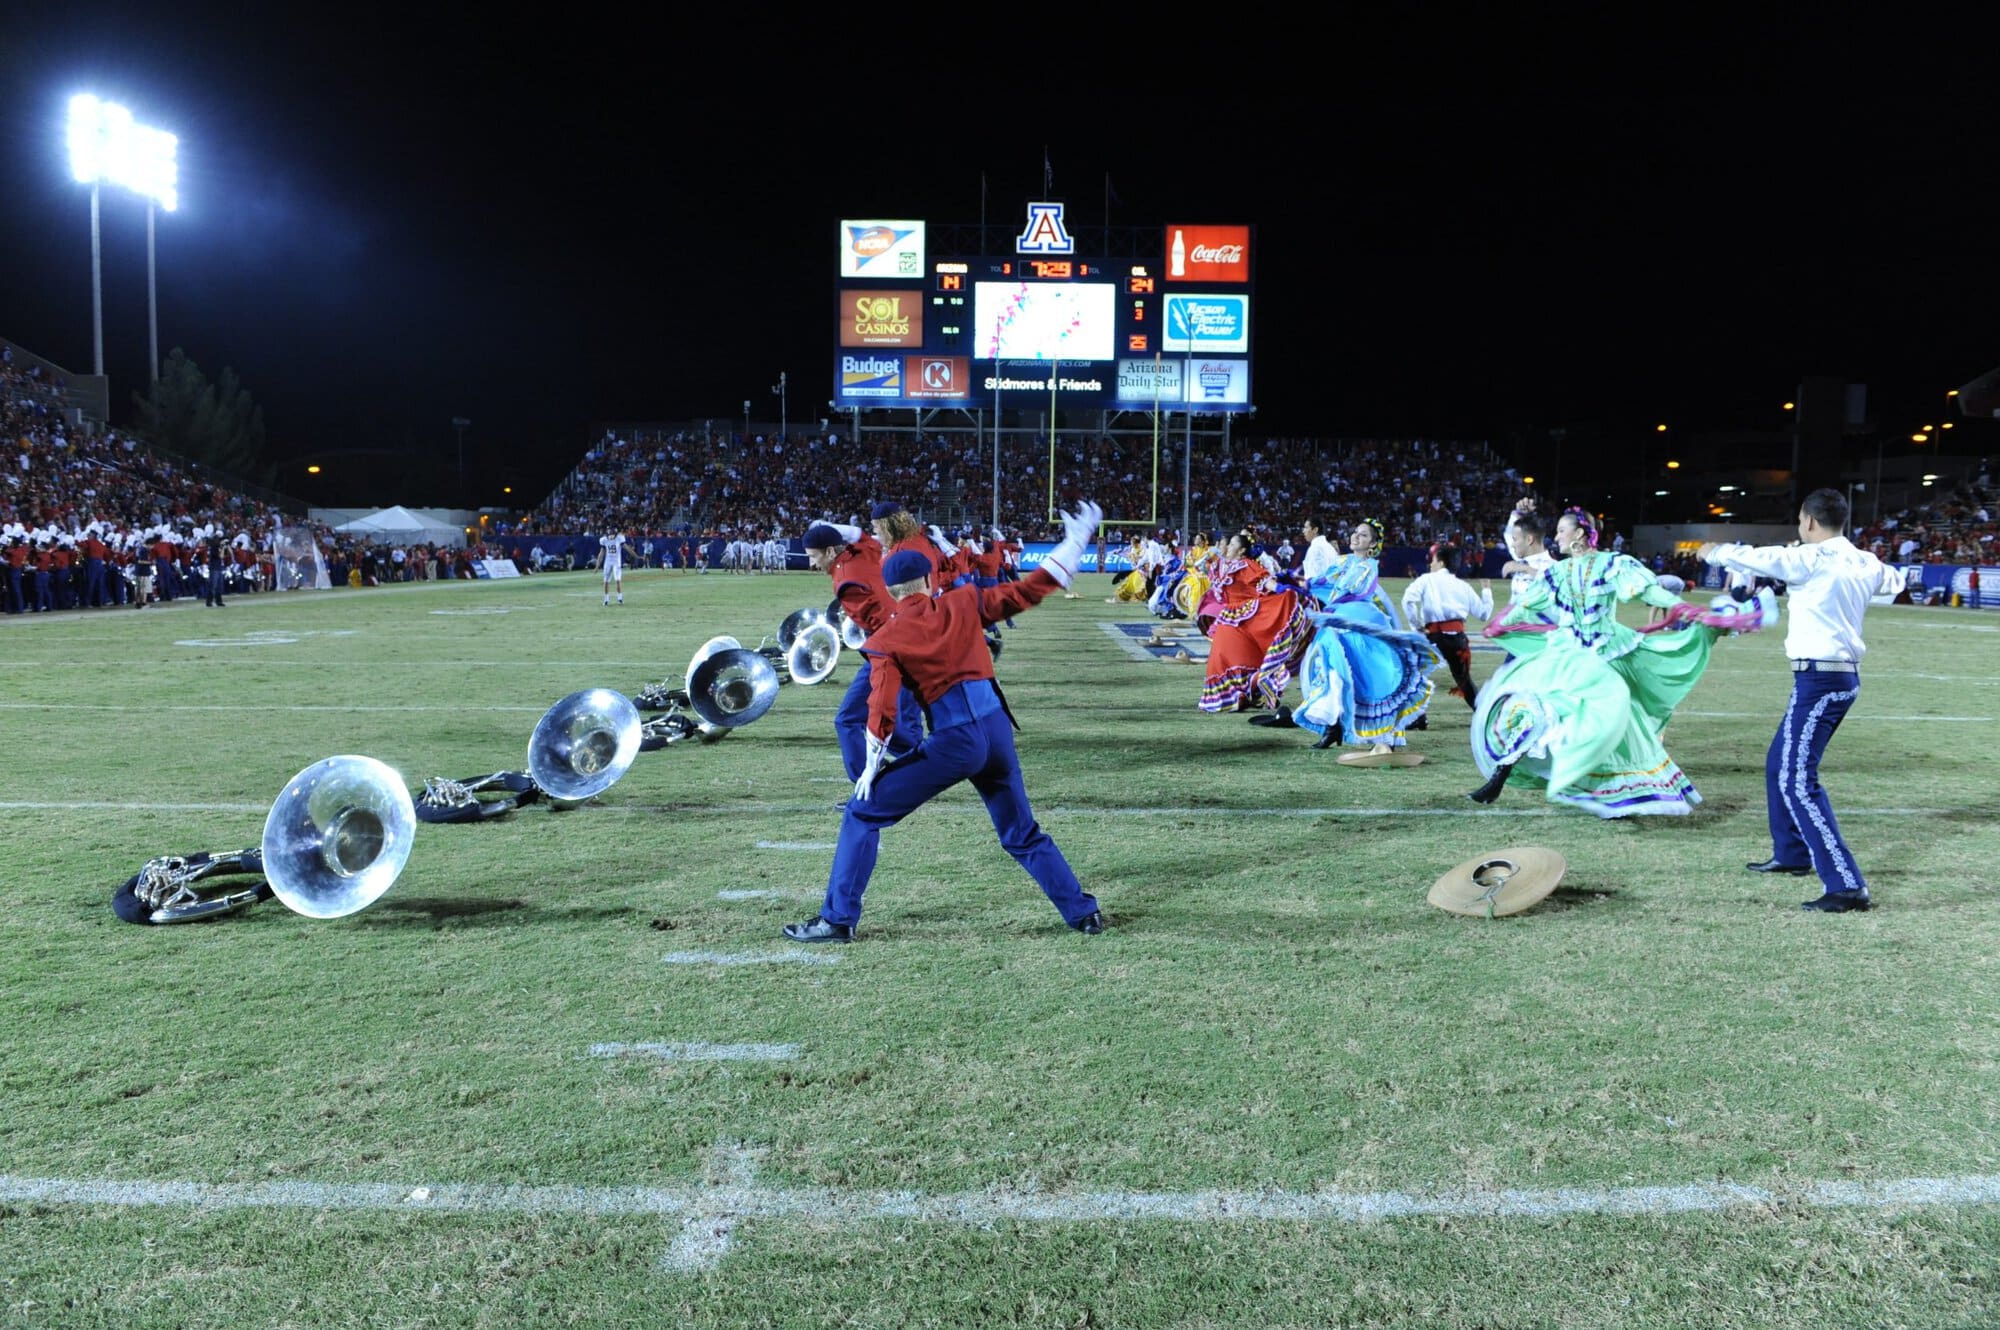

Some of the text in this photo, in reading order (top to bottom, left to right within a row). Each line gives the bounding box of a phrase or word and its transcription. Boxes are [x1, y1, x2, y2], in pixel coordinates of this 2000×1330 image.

[1016, 202, 1074, 254] A
[1031, 261, 1072, 277] 7:29
[943, 275, 959, 290] 14
[1130, 278, 1154, 293] 24
[855, 297, 910, 323] SOL
[1186, 302, 1227, 314] Tucson
[1191, 313, 1237, 325] Electric
[855, 323, 910, 335] CASINOS
[1195, 324, 1237, 336] Power
[842, 356, 899, 377] Budget
[1126, 361, 1173, 374] Arizona
[984, 377, 1102, 391] Skidmores & Friends
[1117, 375, 1180, 389] Daily Star
